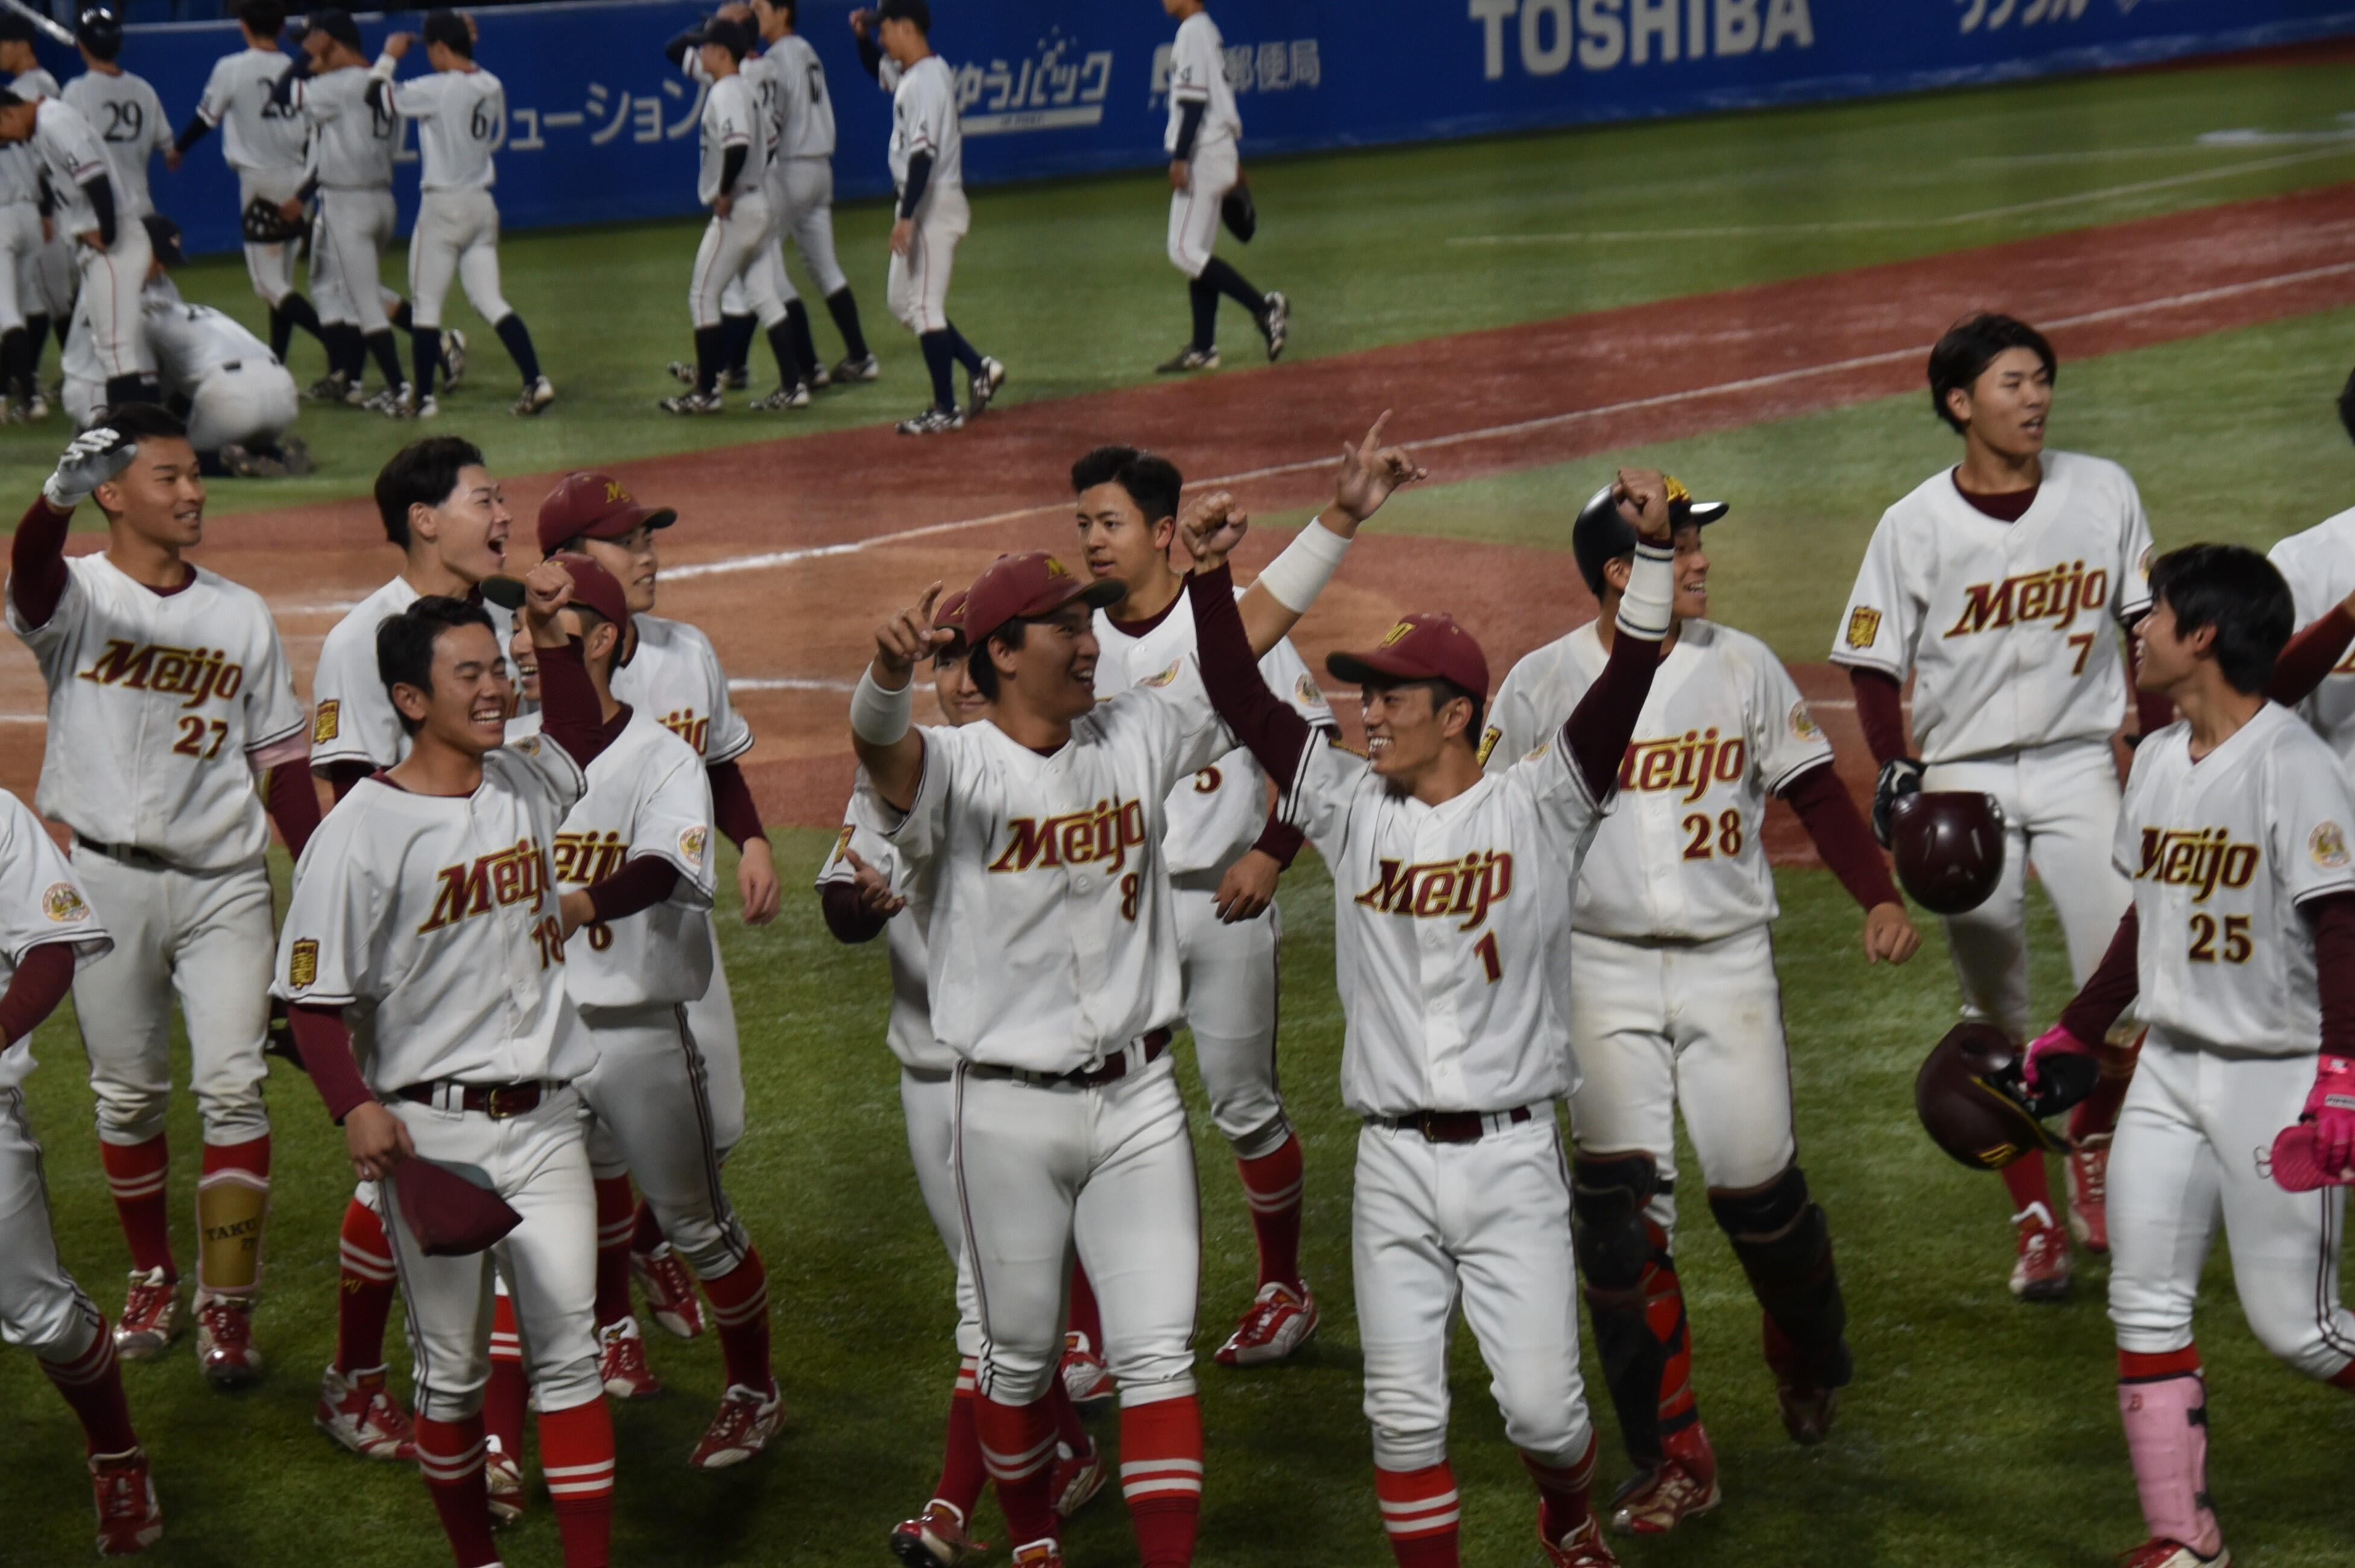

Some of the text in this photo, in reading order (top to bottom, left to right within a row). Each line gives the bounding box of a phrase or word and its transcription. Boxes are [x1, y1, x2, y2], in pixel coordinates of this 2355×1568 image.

[1468, 0, 1814, 80] TOSHIBA
[104, 100, 143, 142] 29
[470, 98, 488, 140] 6
[1942, 558, 2108, 640] Meijo
[77, 638, 243, 709] Meijo
[2067, 631, 2096, 677] 7
[172, 714, 229, 759] 27
[987, 794, 1145, 875] Meijo
[1682, 809, 1742, 862] 28
[2135, 826, 2260, 904] Meijo
[1119, 871, 1139, 923] 8
[1473, 929, 1503, 984] 1
[2187, 910, 2254, 966] 25
